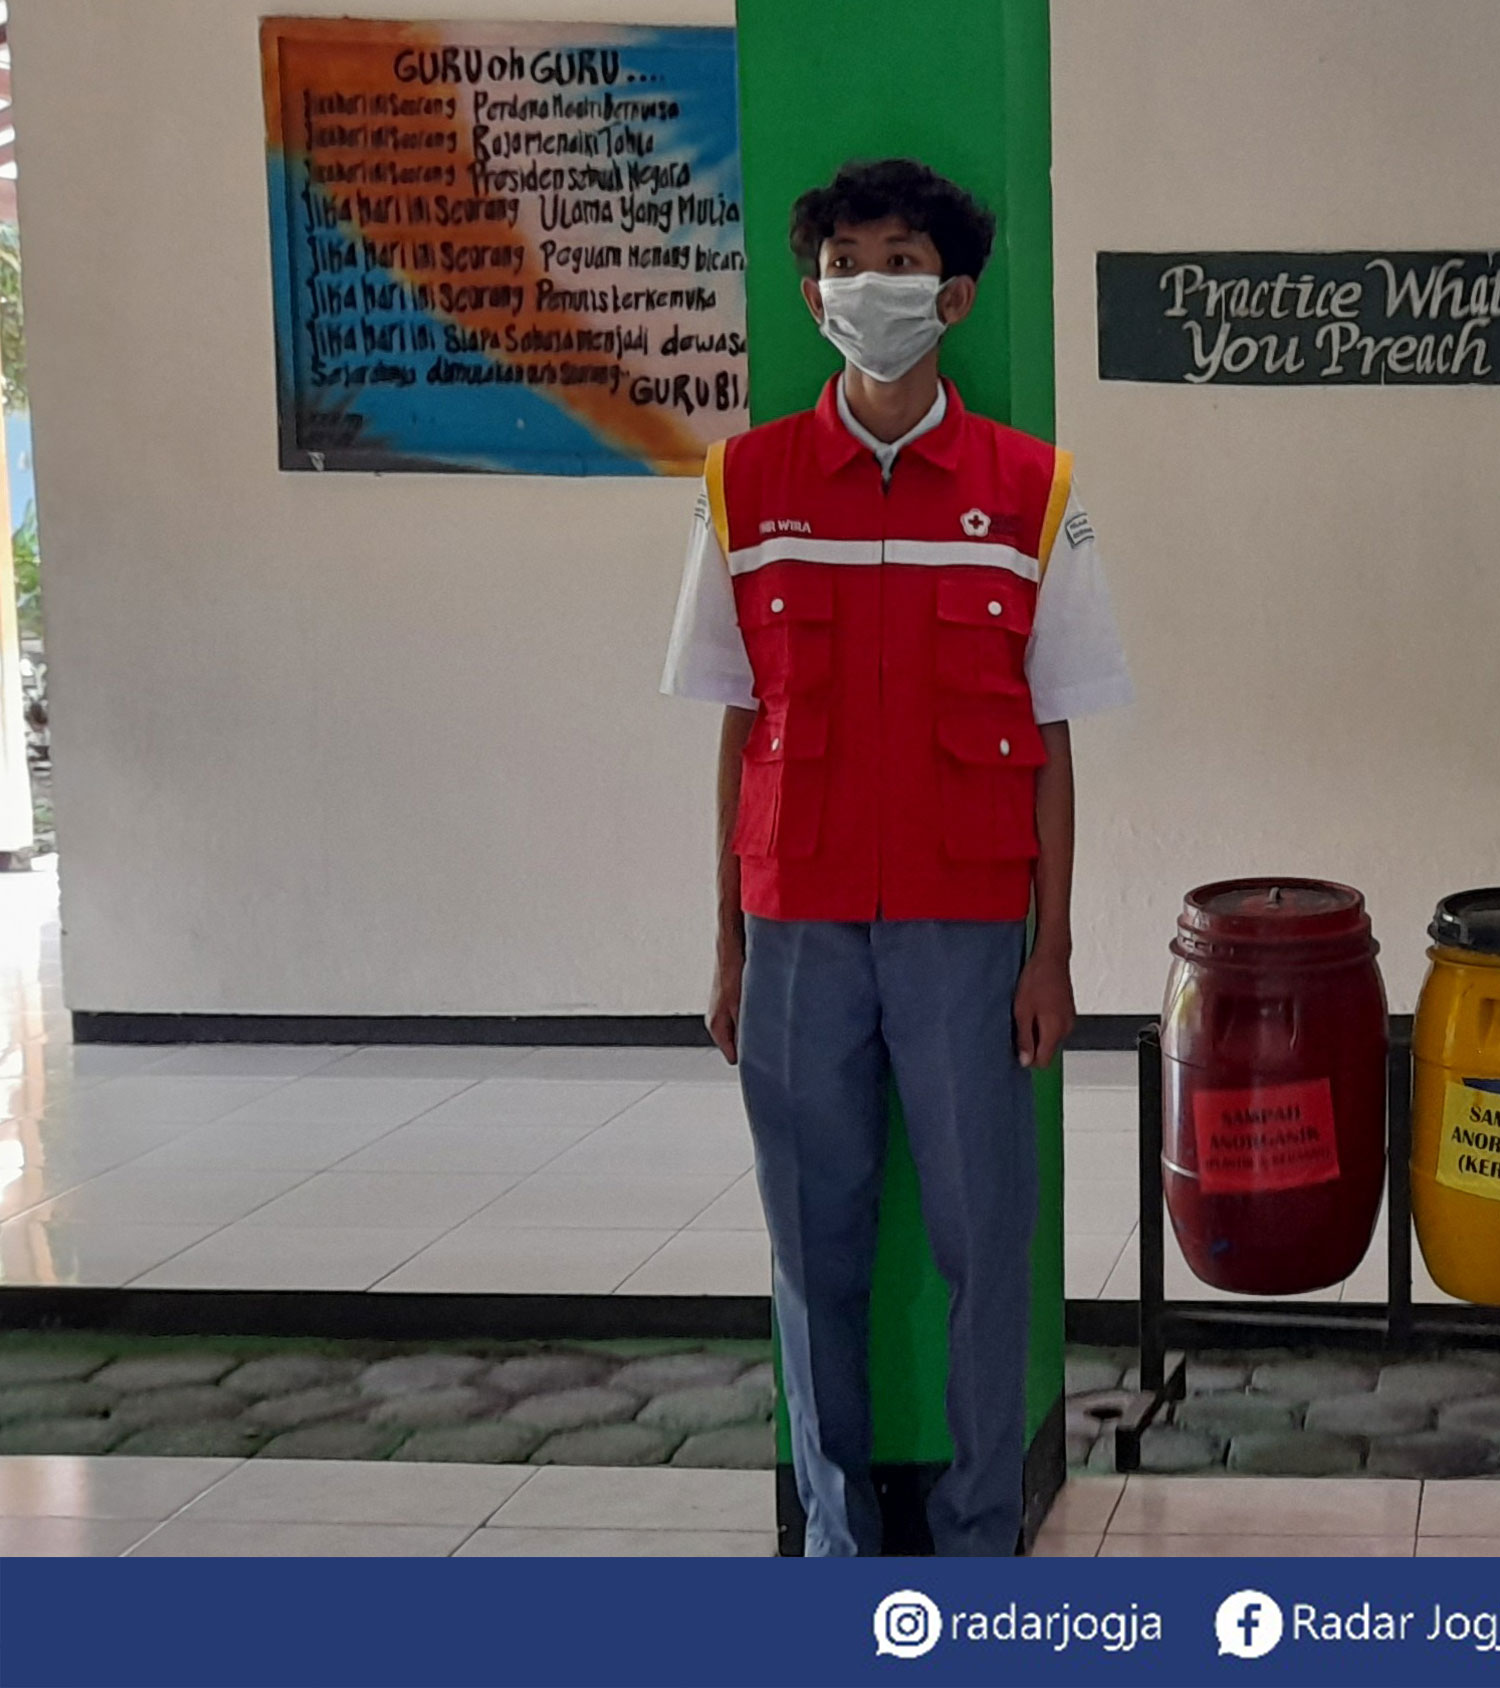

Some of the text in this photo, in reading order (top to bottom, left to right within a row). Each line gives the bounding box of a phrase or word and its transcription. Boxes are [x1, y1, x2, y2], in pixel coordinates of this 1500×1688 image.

[393, 47, 483, 84] GURU
[487, 47, 525, 82] oh
[473, 125, 522, 161] Raja
[467, 160, 565, 196] Presiden
[626, 160, 692, 195] Negara
[1160, 263, 1363, 319] Practice
[1183, 316, 1492, 383] You Preach
[629, 372, 709, 416] GURU
[777, 518, 812, 535] WIRA
